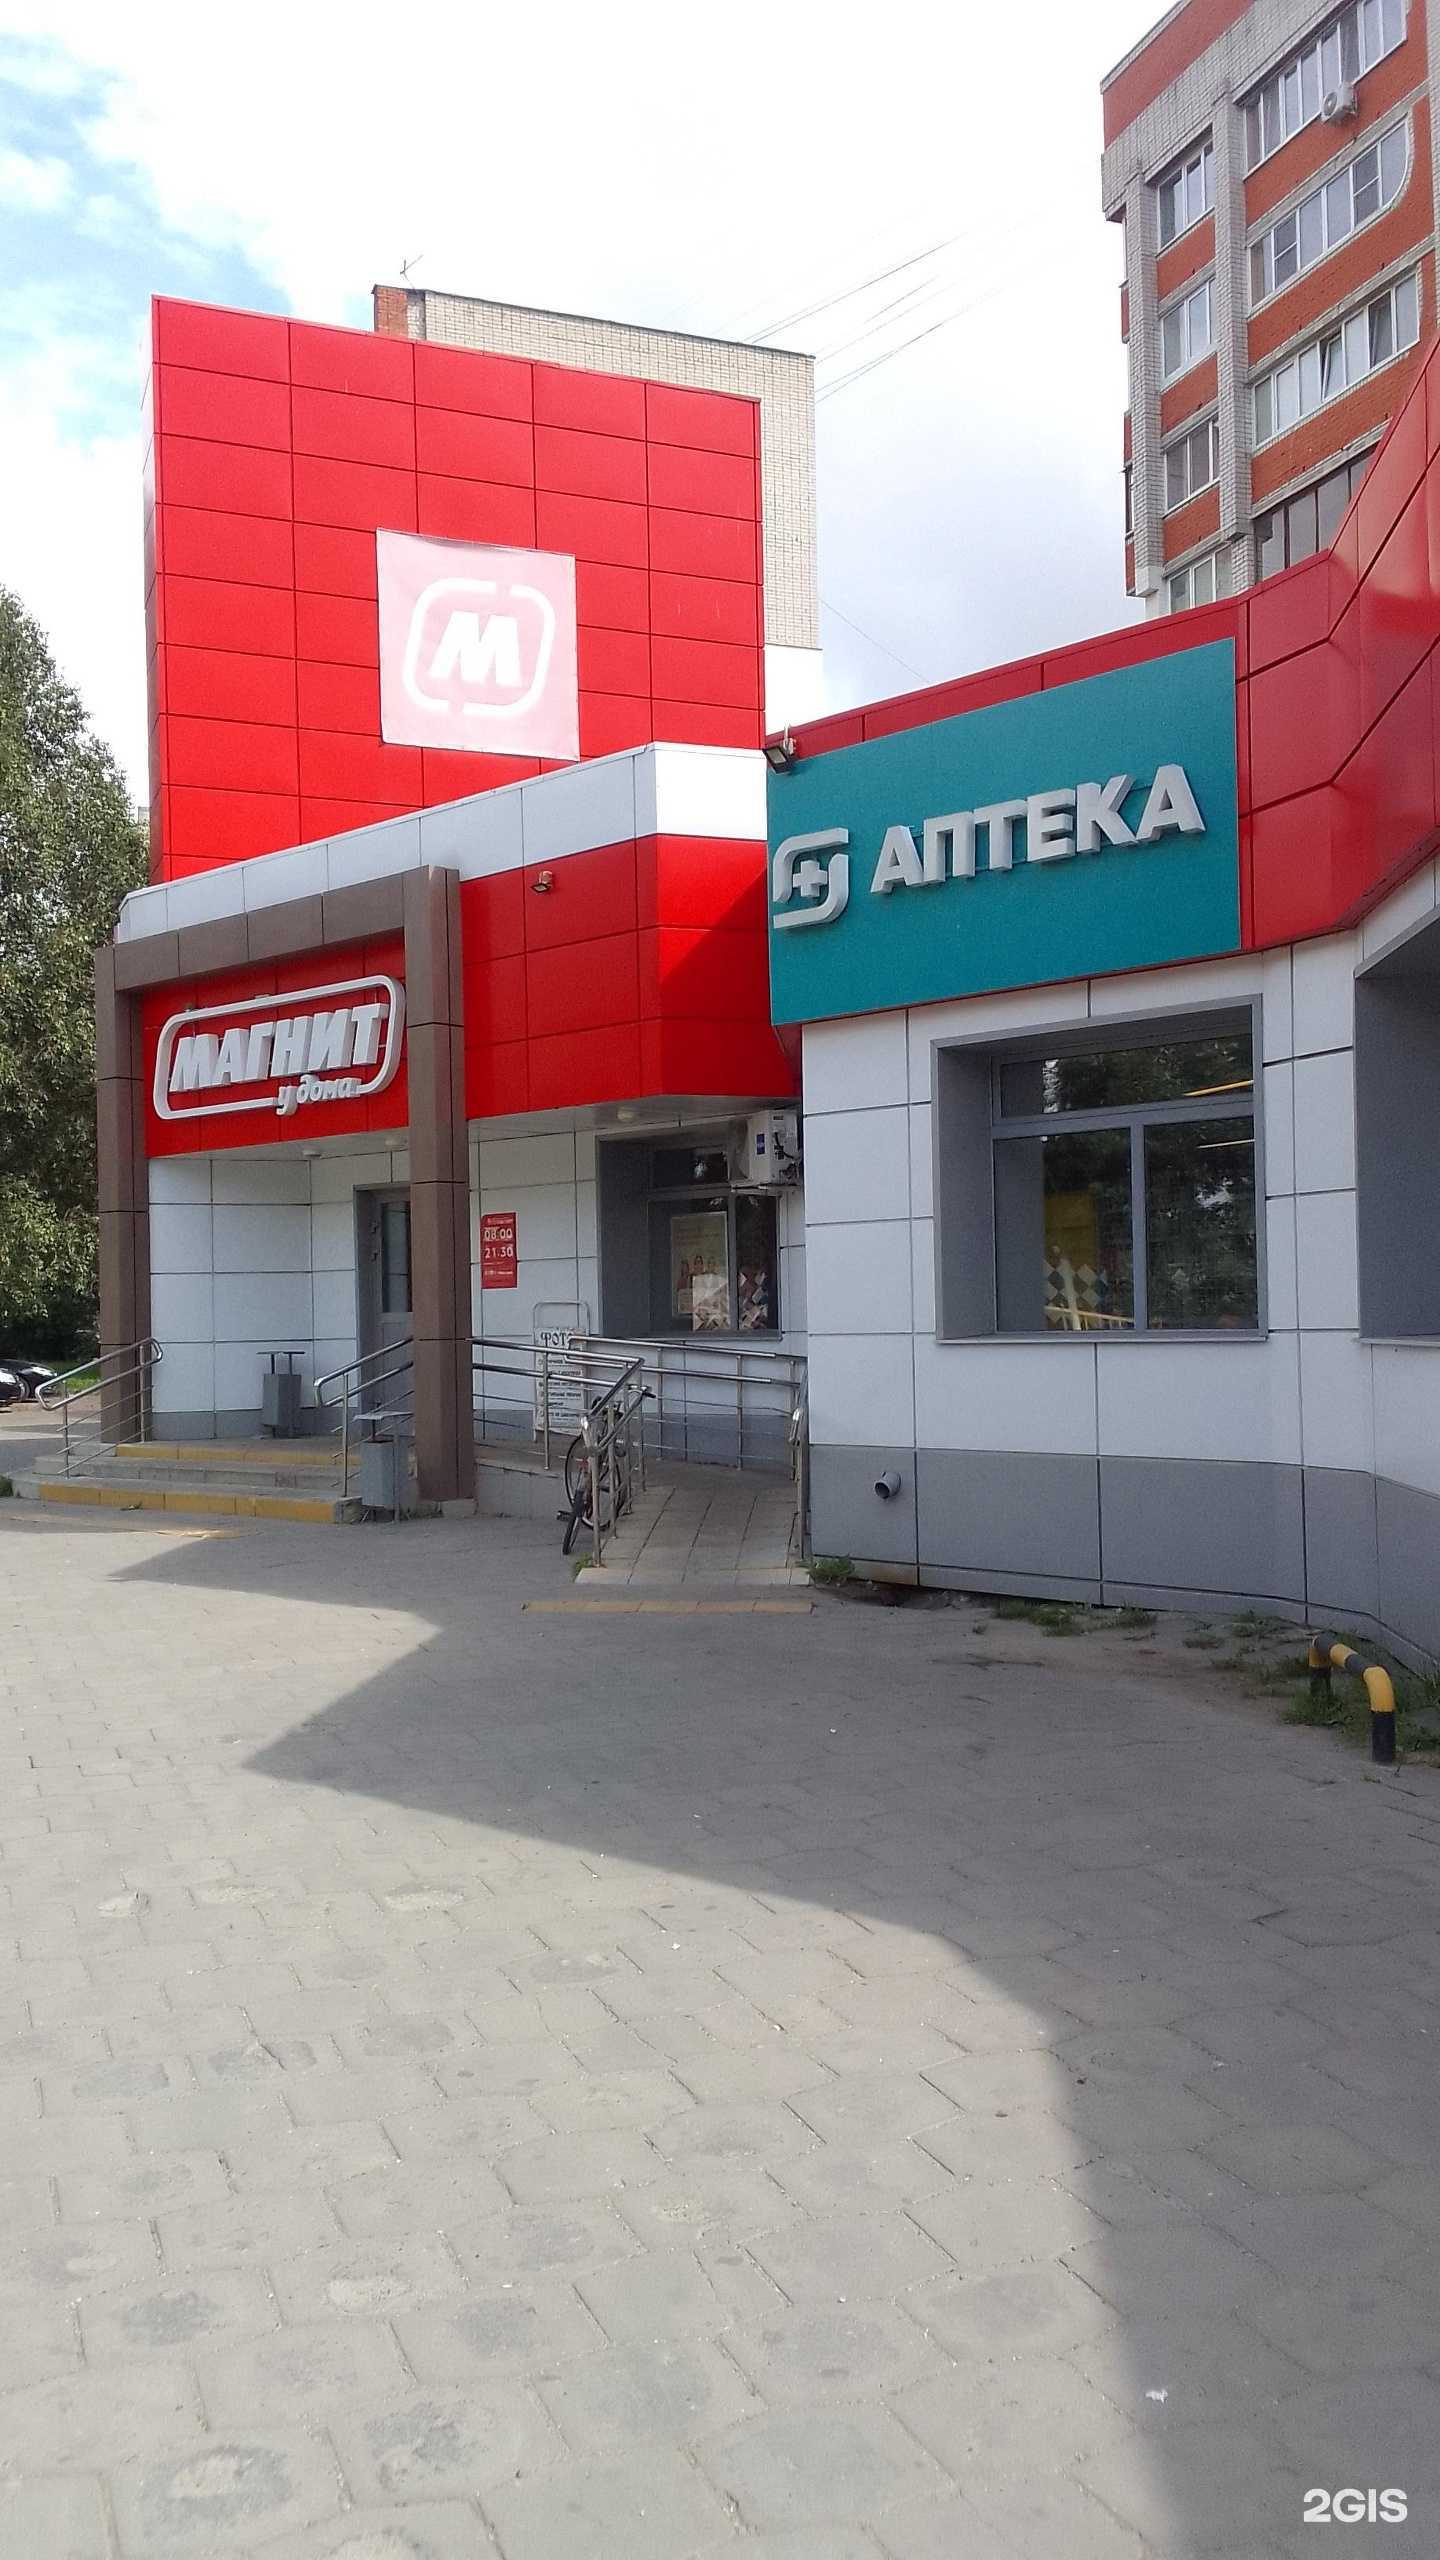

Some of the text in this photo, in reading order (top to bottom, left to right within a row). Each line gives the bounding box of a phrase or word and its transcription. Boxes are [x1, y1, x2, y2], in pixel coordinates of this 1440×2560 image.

[429, 611, 522, 686] М
[871, 764, 1206, 894] АПТЕКА
[169, 1003, 389, 1092] МАГНИТ
[276, 1074, 361, 1116] у дома
